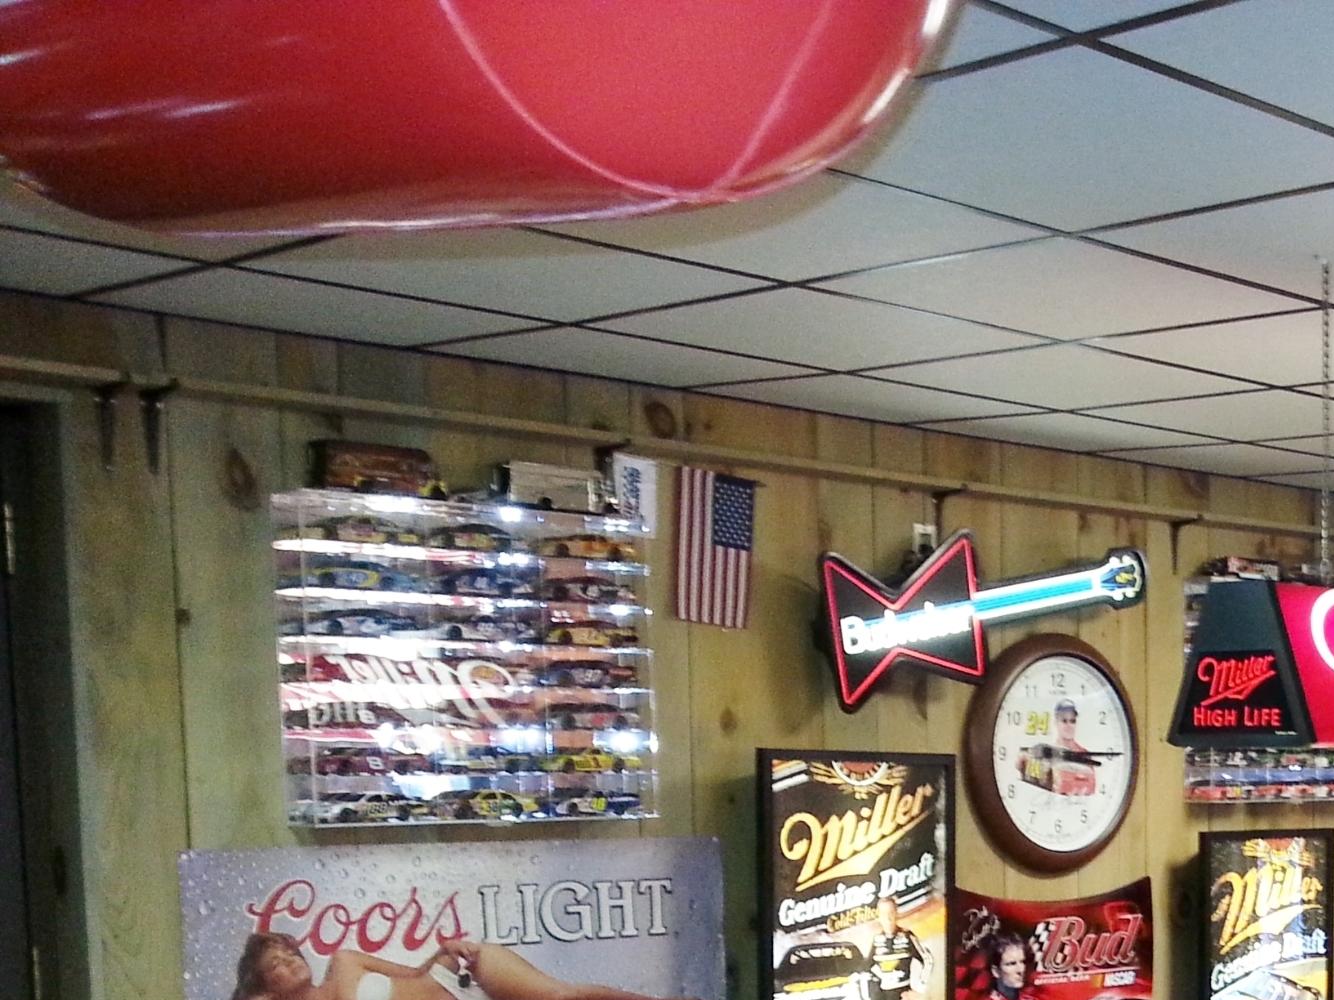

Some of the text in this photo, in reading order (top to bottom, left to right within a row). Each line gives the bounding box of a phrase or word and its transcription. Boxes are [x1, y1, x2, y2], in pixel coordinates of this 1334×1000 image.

[1050, 674, 1065, 688] 12
[1197, 655, 1275, 696] Miller
[1025, 685, 1039, 697] 11
[1080, 685, 1086, 695] 1
[1007, 712, 1020, 724] 10
[1099, 711, 1107, 725] 2
[1193, 706, 1282, 728] HIGH LIFE
[1008, 784, 1016, 798] 8
[1029, 811, 1037, 824] 7
[1080, 810, 1089, 823] 5
[1054, 820, 1062, 833] 6
[780, 784, 935, 884] Miller
[778, 852, 935, 926] Genuine Draft
[1210, 864, 1323, 947] Miller
[247, 878, 673, 956] Coors LIGHT
[1042, 914, 1143, 973] Bud
